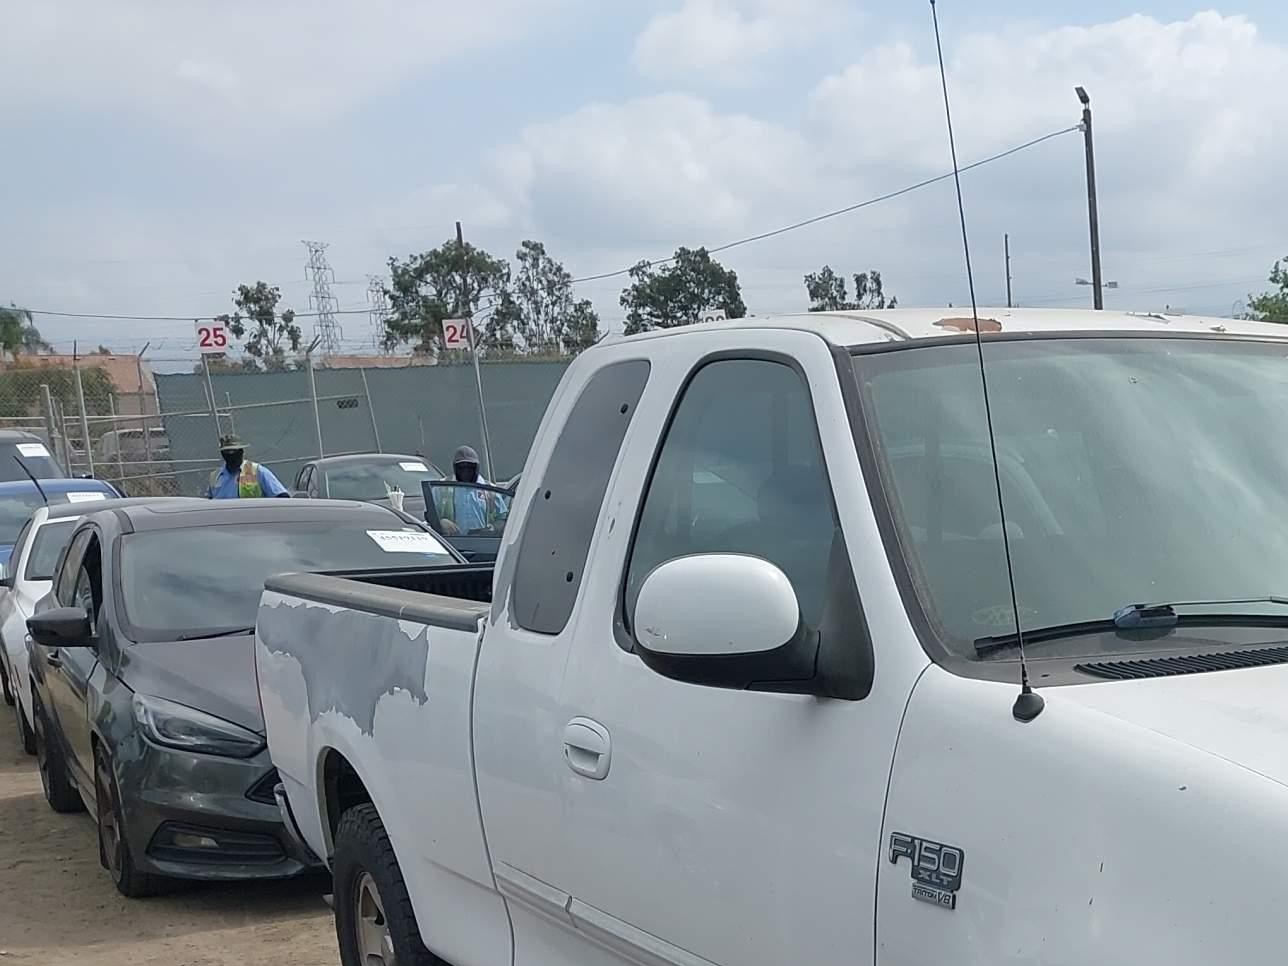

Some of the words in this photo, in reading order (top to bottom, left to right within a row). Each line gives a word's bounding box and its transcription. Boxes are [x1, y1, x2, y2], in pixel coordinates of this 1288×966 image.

[198, 327, 227, 347] 25
[918, 870, 953, 885] XLT
[937, 891, 952, 905] V8
